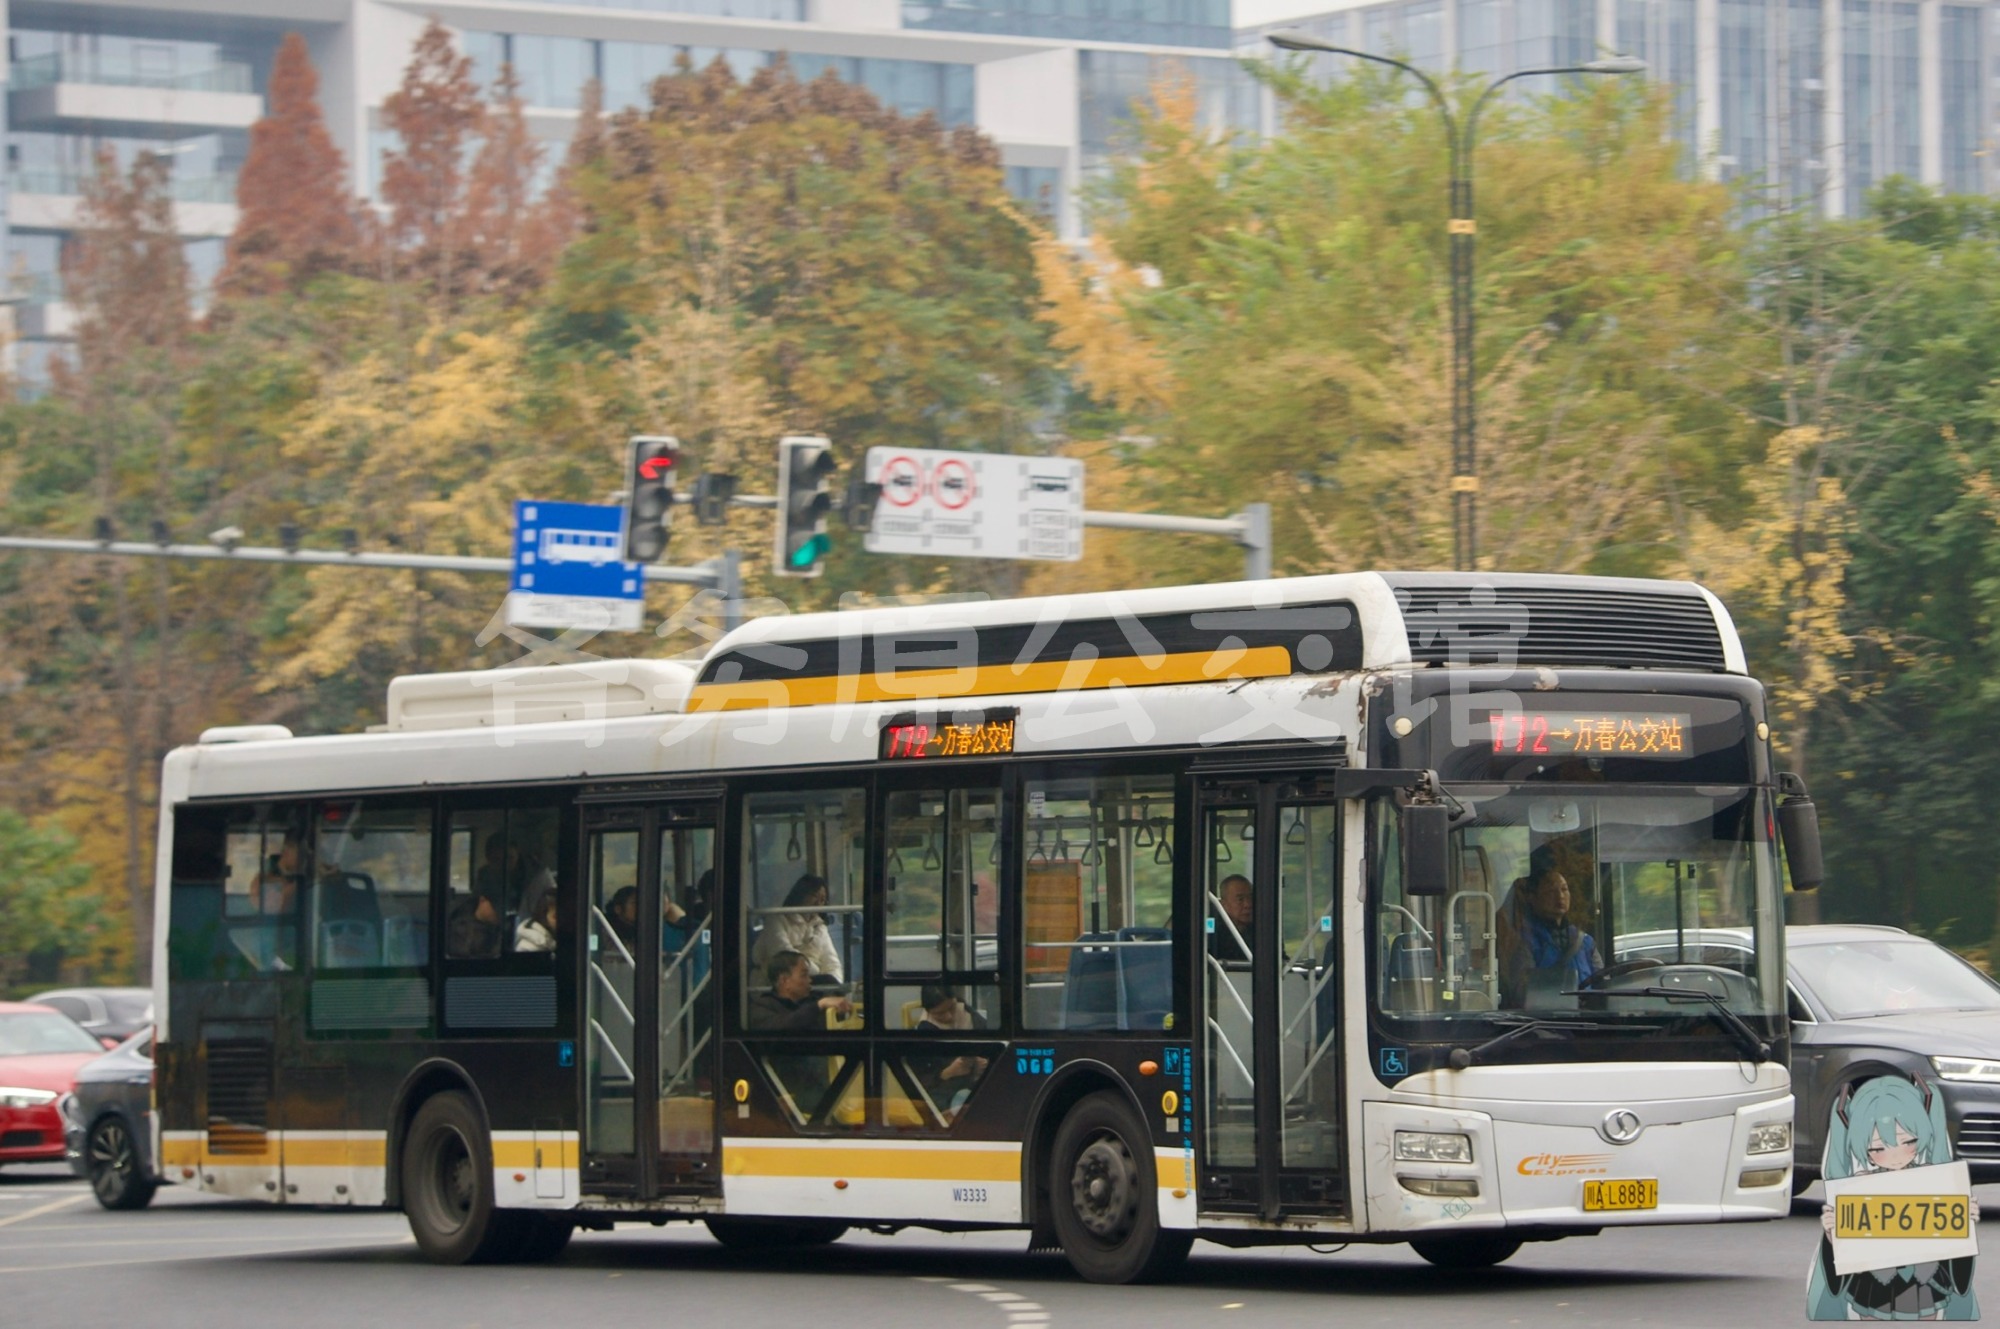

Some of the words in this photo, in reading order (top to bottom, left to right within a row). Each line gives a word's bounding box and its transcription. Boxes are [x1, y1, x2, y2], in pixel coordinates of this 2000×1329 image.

[888, 725, 928, 758] 772
[941, 720, 1014, 756] 万春公交站
[1489, 715, 1549, 752] 772
[1573, 717, 1683, 752] 万春公交站
[1517, 1152, 1561, 1176] City
[1532, 1168, 1607, 1176] Express
[953, 1188, 987, 1202] W3333
